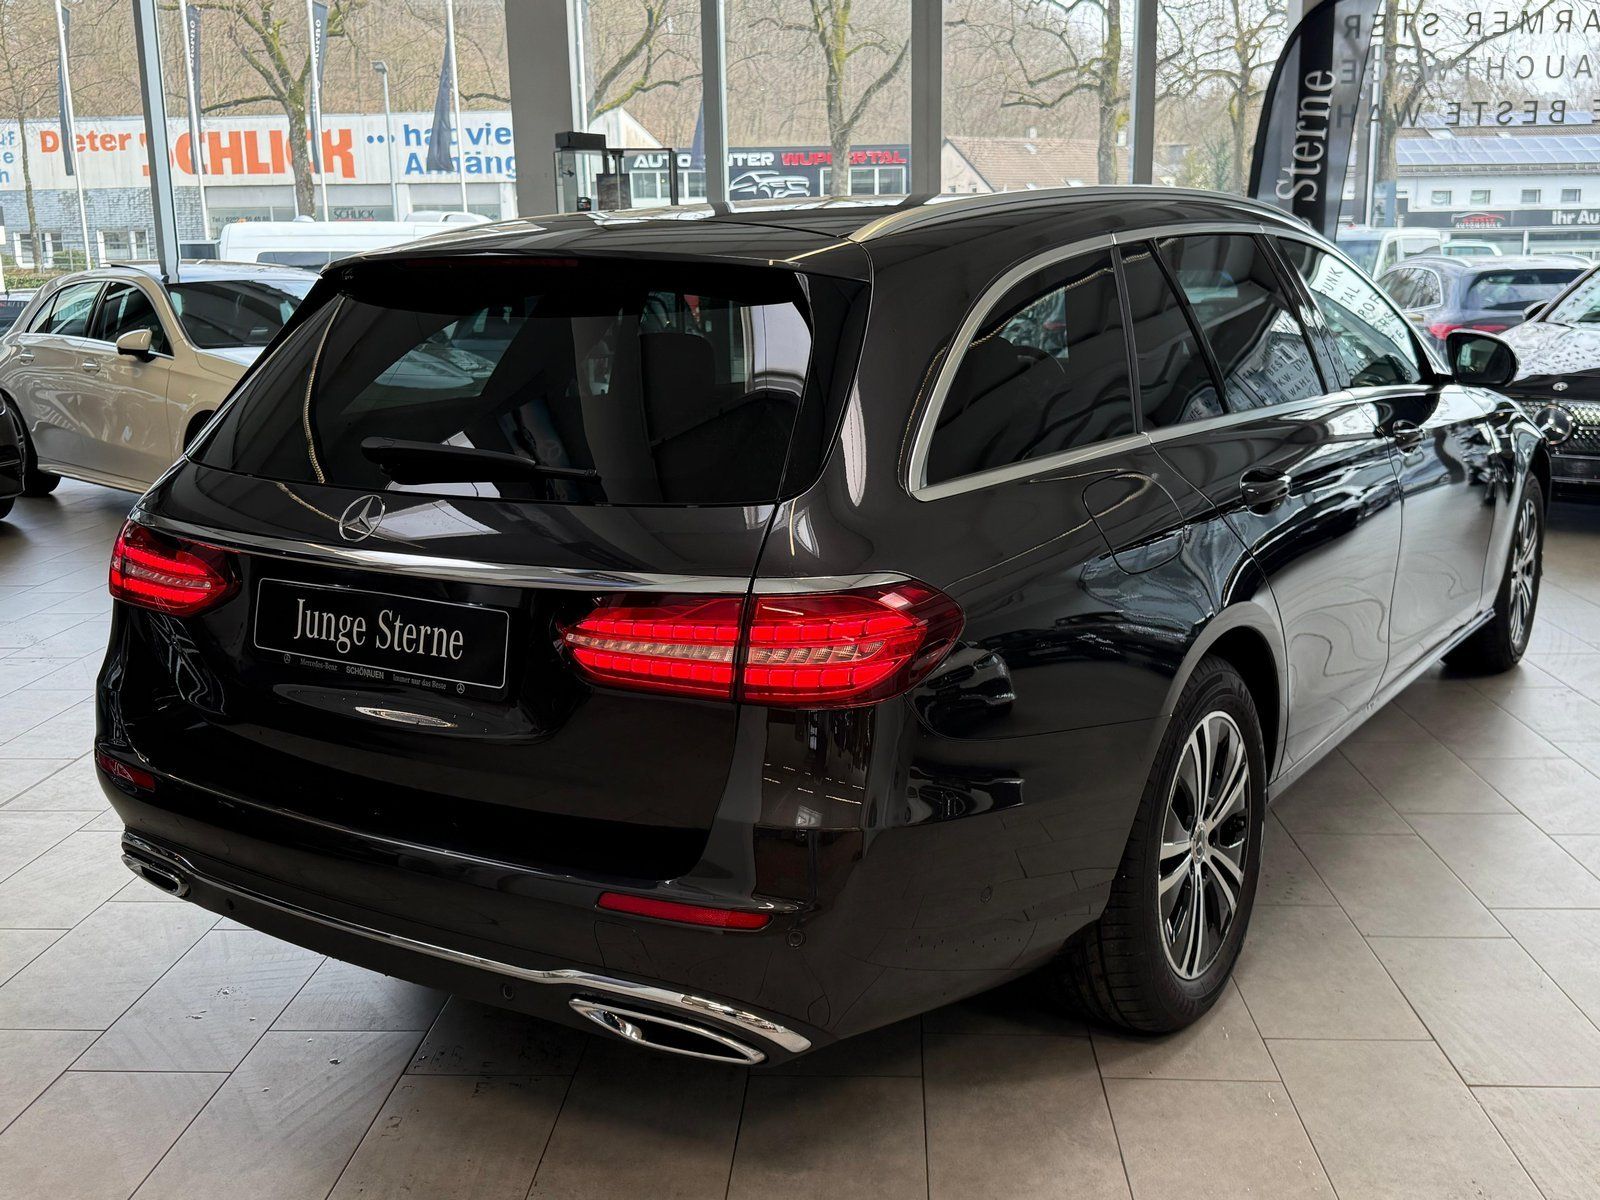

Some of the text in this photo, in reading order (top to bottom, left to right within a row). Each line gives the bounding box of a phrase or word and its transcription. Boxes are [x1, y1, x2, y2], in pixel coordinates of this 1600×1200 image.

[1276, 69, 1336, 202] Sterne
[1552, 209, 1576, 225] Ihr
[294, 598, 464, 660] Junge Sterne
